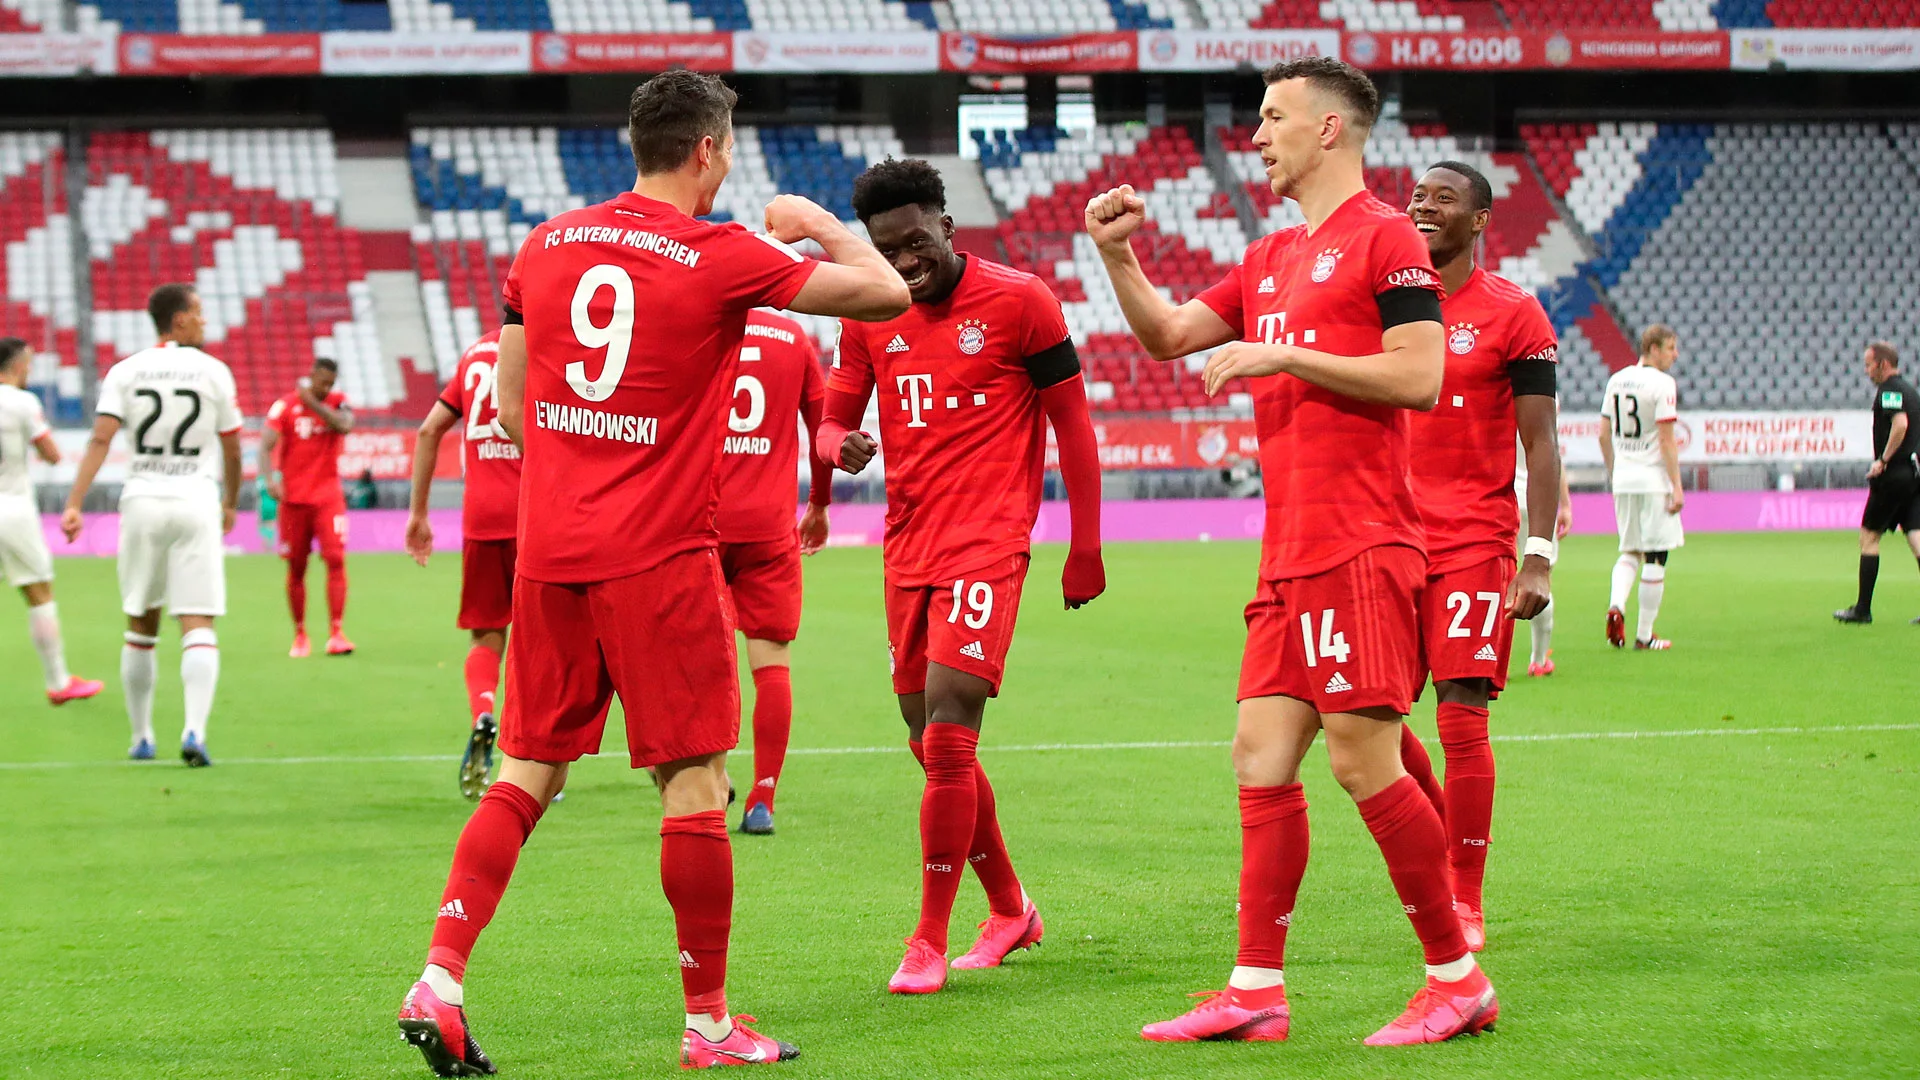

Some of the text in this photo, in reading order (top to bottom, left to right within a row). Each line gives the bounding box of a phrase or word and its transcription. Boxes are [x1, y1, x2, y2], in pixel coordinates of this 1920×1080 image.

[1195, 40, 1321, 60] HACIENDA
[1391, 36, 1523, 64] H.P. 2006
[544, 229, 561, 249] FC
[563, 226, 622, 243] BAYERN
[565, 264, 635, 402] 9
[728, 346, 765, 432] 5
[134, 388, 201, 454] 22
[1613, 394, 1641, 438] 13
[723, 436, 771, 455] AVARD
[947, 579, 994, 630] 19
[1446, 591, 1500, 638] 27
[1300, 609, 1351, 667] 14
[1463, 838, 1486, 846] FCB
[926, 863, 952, 873] FCB
